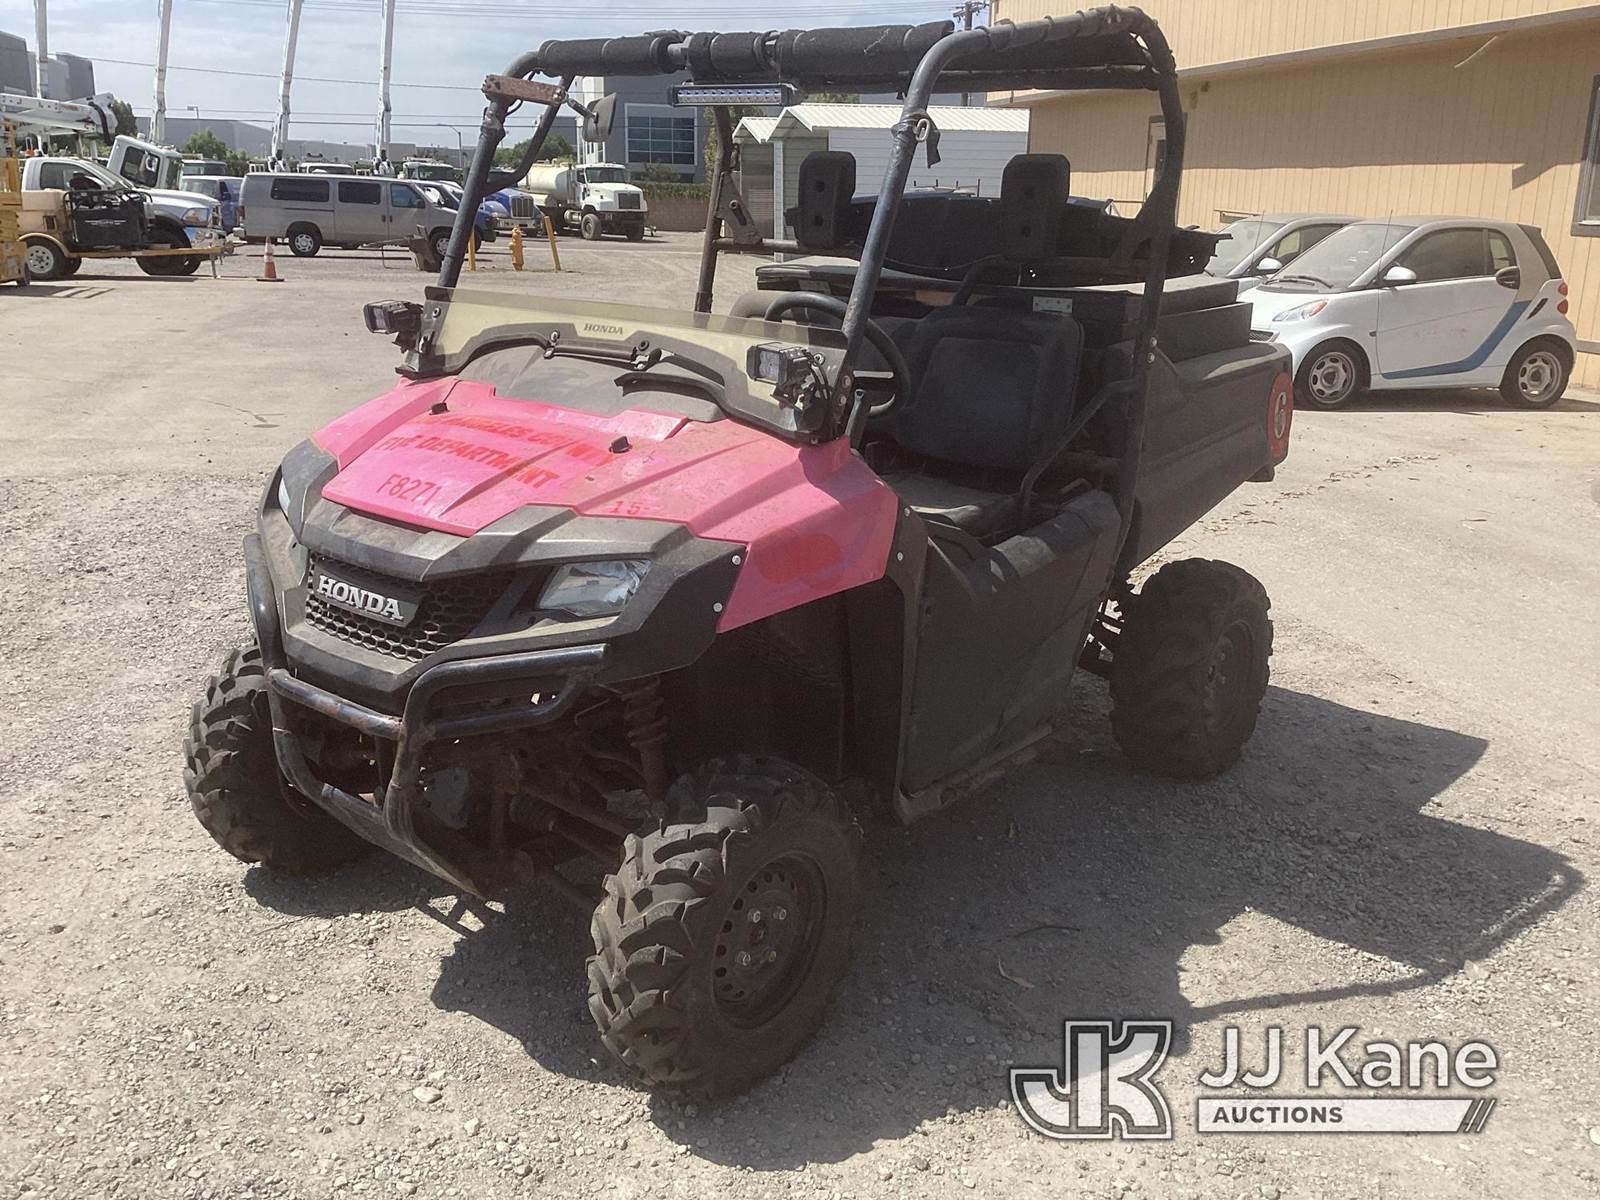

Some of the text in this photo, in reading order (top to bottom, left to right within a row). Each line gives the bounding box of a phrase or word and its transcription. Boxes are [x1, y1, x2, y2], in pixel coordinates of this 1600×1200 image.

[583, 323, 624, 335] HONDA
[1273, 391, 1287, 439] 6
[376, 473, 443, 506] F8271
[316, 574, 404, 620] HONDA
